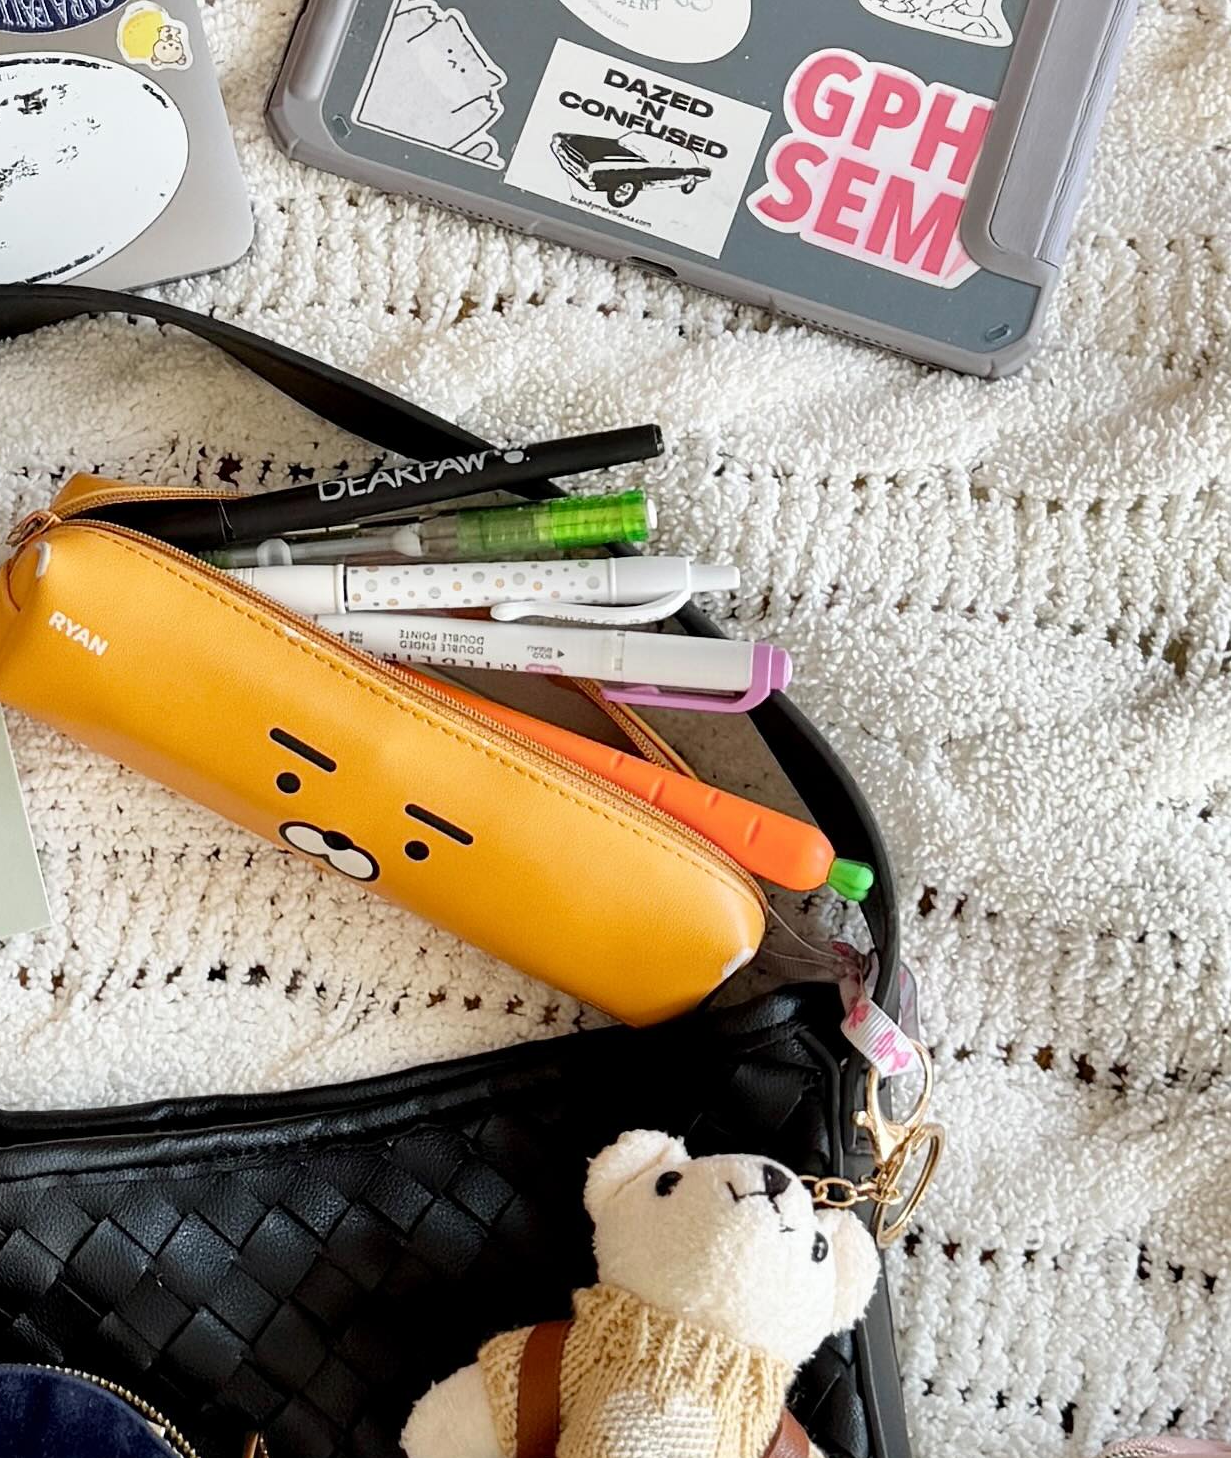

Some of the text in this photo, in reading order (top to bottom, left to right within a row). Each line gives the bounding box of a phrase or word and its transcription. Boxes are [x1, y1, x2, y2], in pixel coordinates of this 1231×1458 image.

[558, 90, 729, 160] CONFUSED
[602, 67, 715, 121] DAZED
[794, 55, 995, 185] GPH
[47, 609, 111, 659] RYAN
